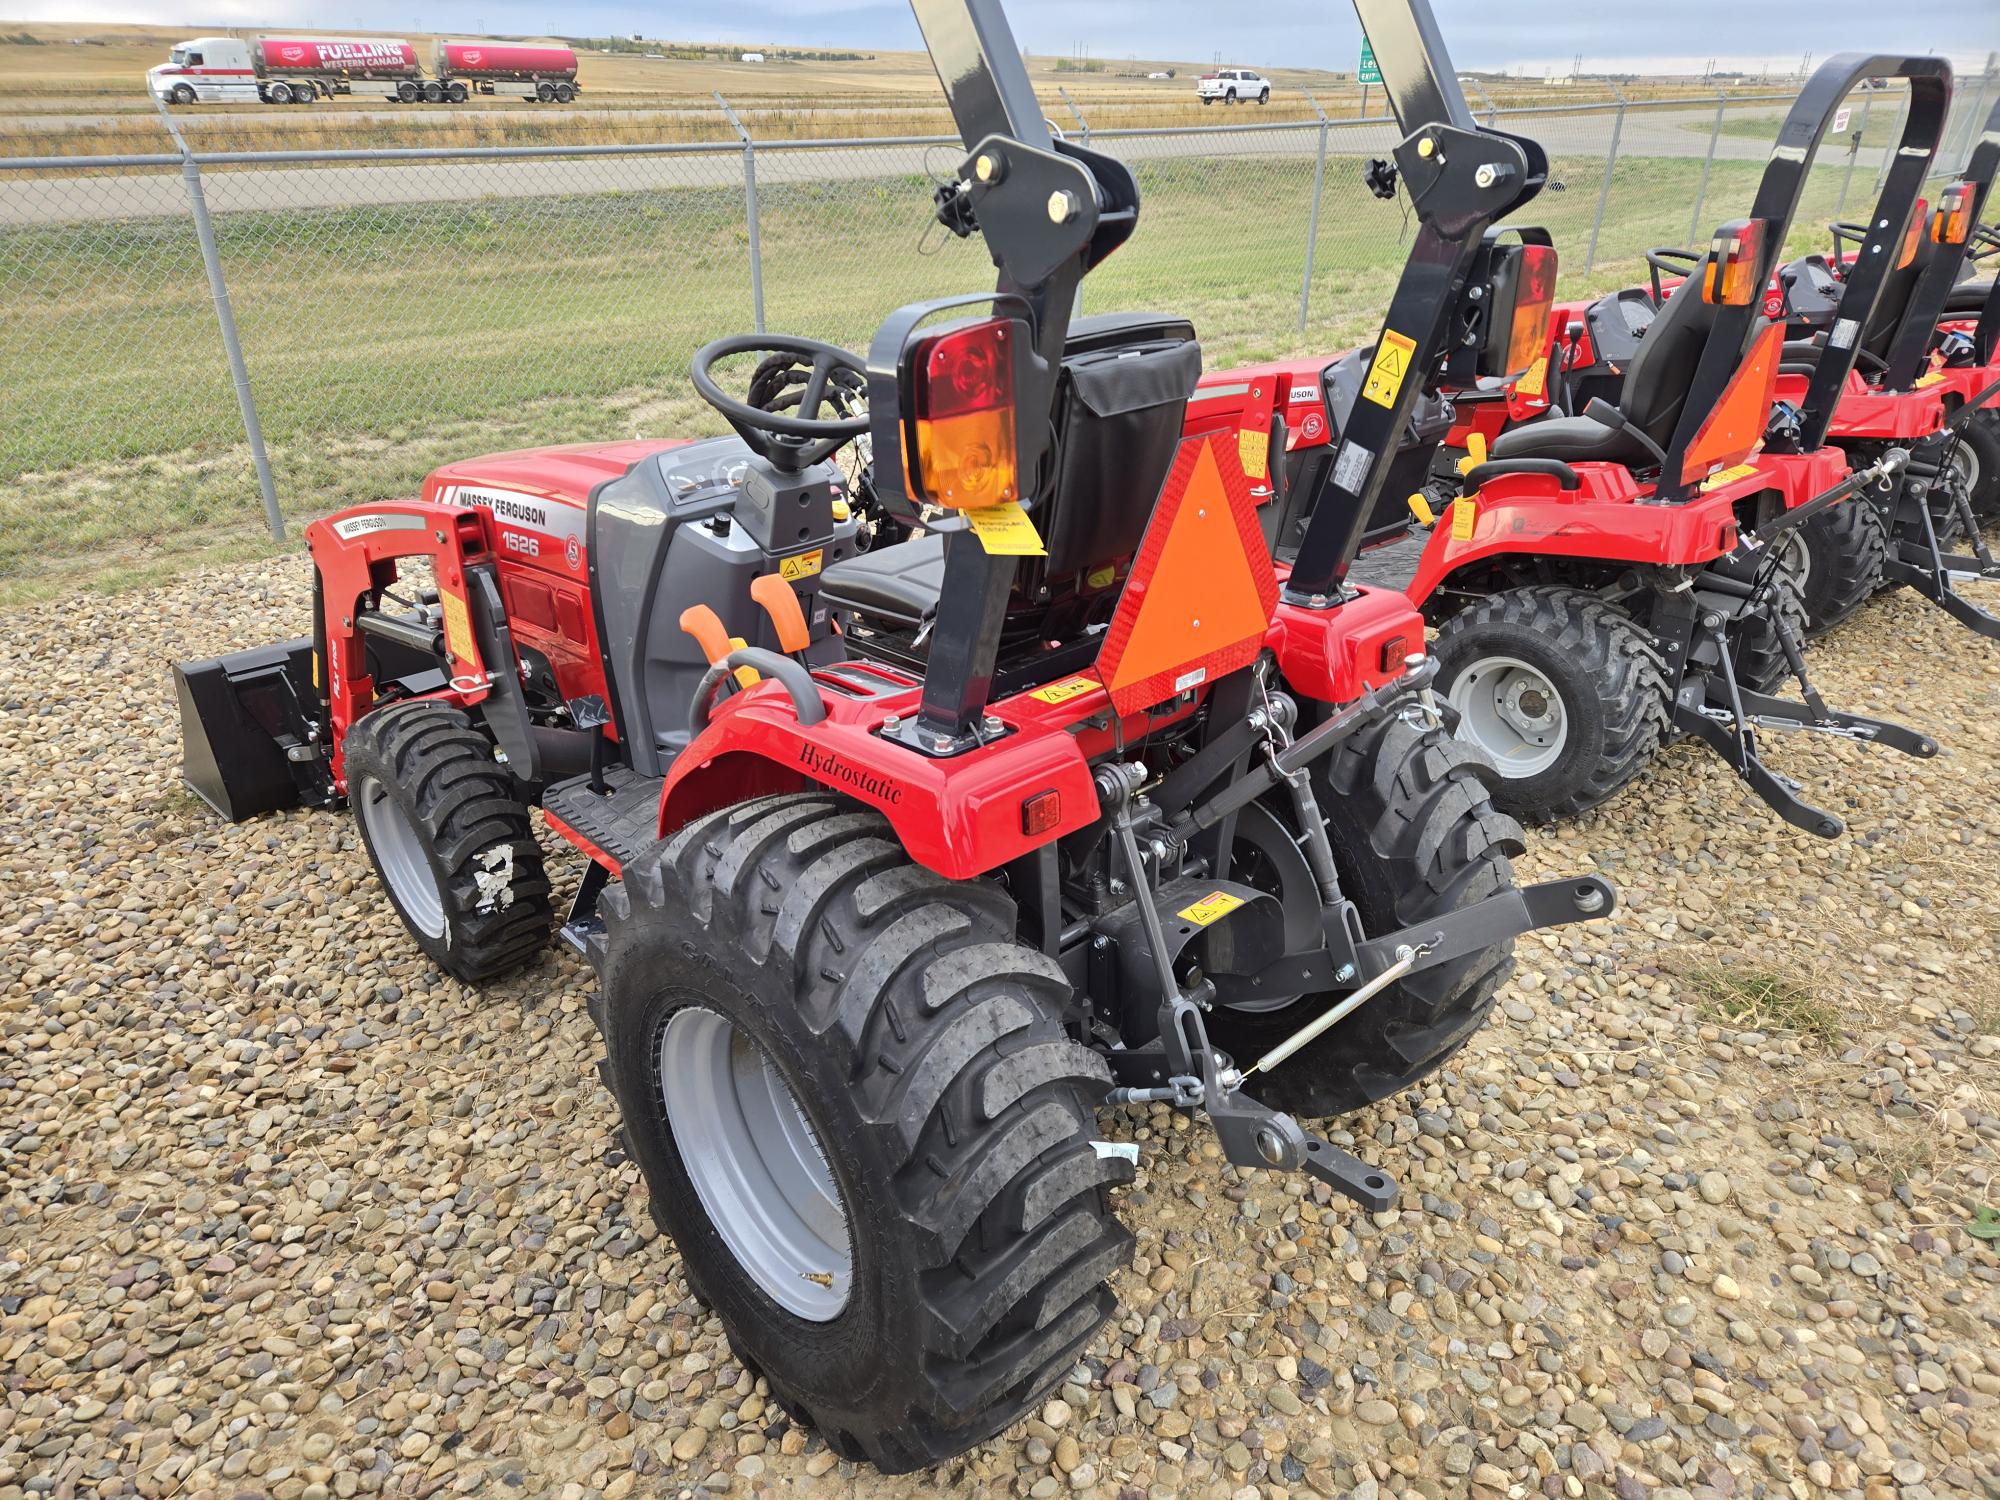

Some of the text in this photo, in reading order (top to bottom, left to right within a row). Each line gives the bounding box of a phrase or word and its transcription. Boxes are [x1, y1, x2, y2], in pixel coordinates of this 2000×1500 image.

[316, 44, 402, 59] FUELLING
[321, 56, 405, 69] WESTERN CANADA
[1291, 390, 1313, 399] USON
[495, 500, 546, 526] FERGUSON
[502, 531, 539, 557] 1526
[799, 743, 902, 805] Hydrostatic
